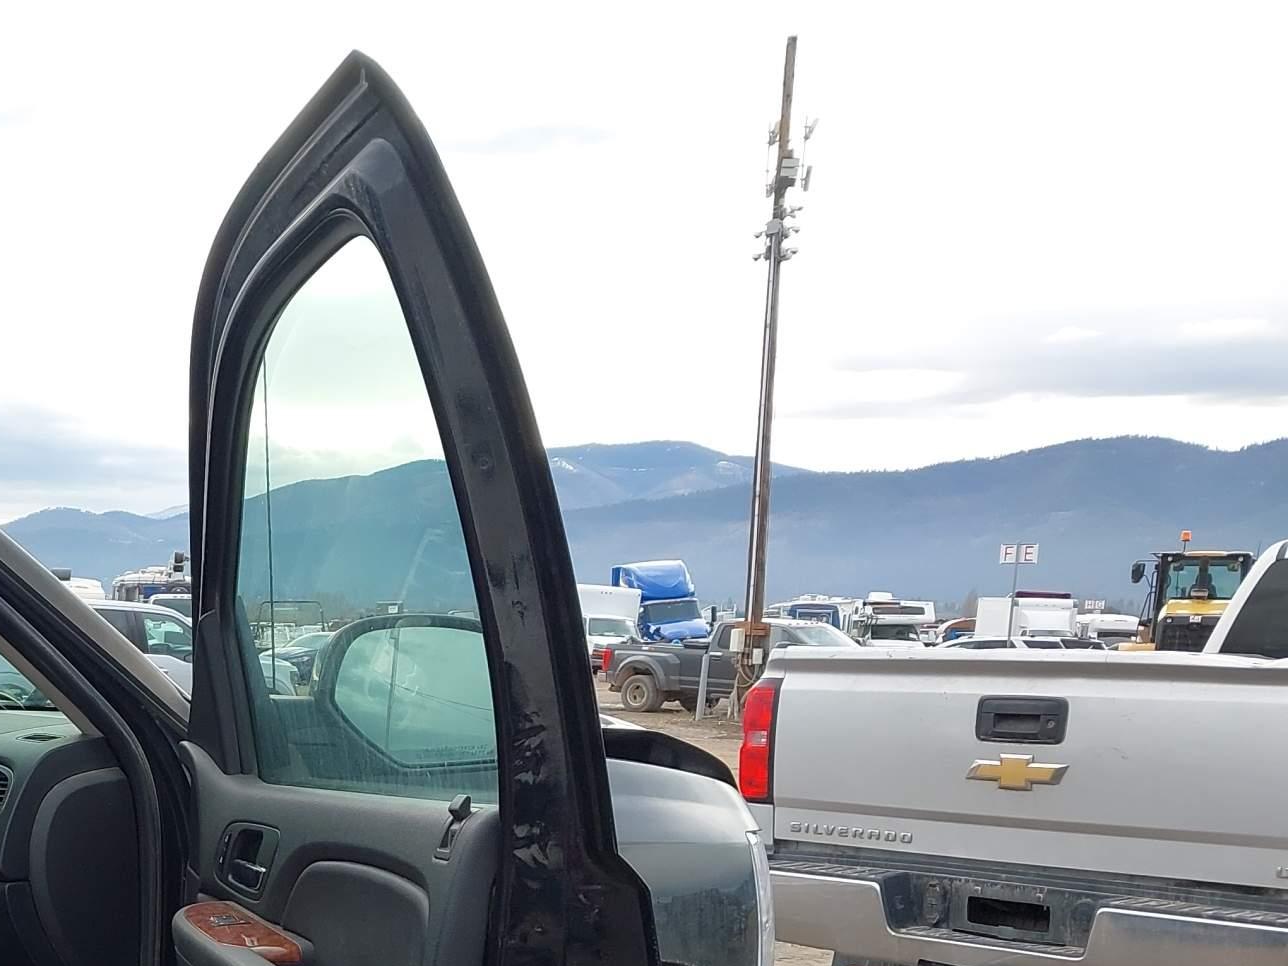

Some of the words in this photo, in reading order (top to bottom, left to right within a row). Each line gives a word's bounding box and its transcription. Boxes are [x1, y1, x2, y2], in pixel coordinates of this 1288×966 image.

[1003, 546, 1014, 561] F
[1023, 545, 1035, 561] E
[790, 821, 913, 844] SILVERADO
